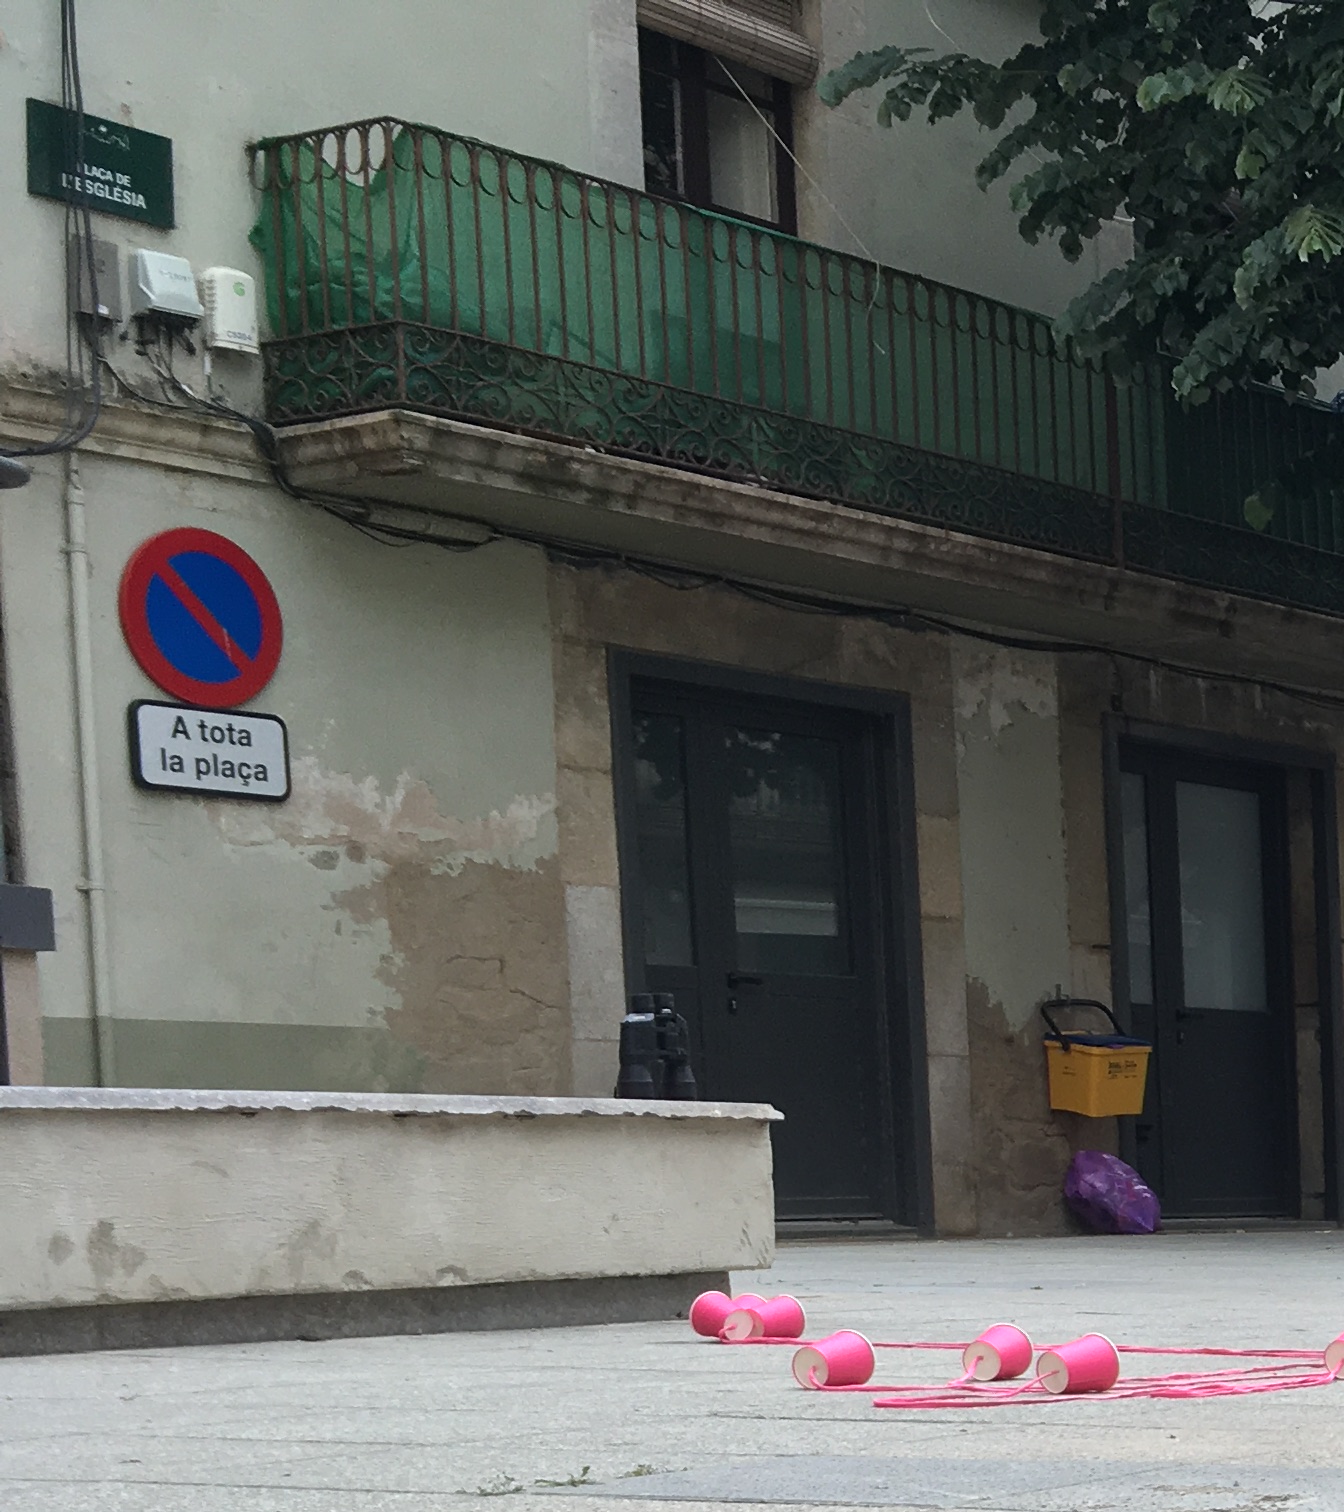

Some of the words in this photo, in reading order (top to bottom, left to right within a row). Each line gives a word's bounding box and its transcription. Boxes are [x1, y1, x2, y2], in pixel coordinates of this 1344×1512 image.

[115, 172, 131, 188] DE
[171, 715, 191, 741] A
[197, 719, 253, 748] tota
[161, 747, 184, 774] la
[195, 753, 268, 787] plaça
